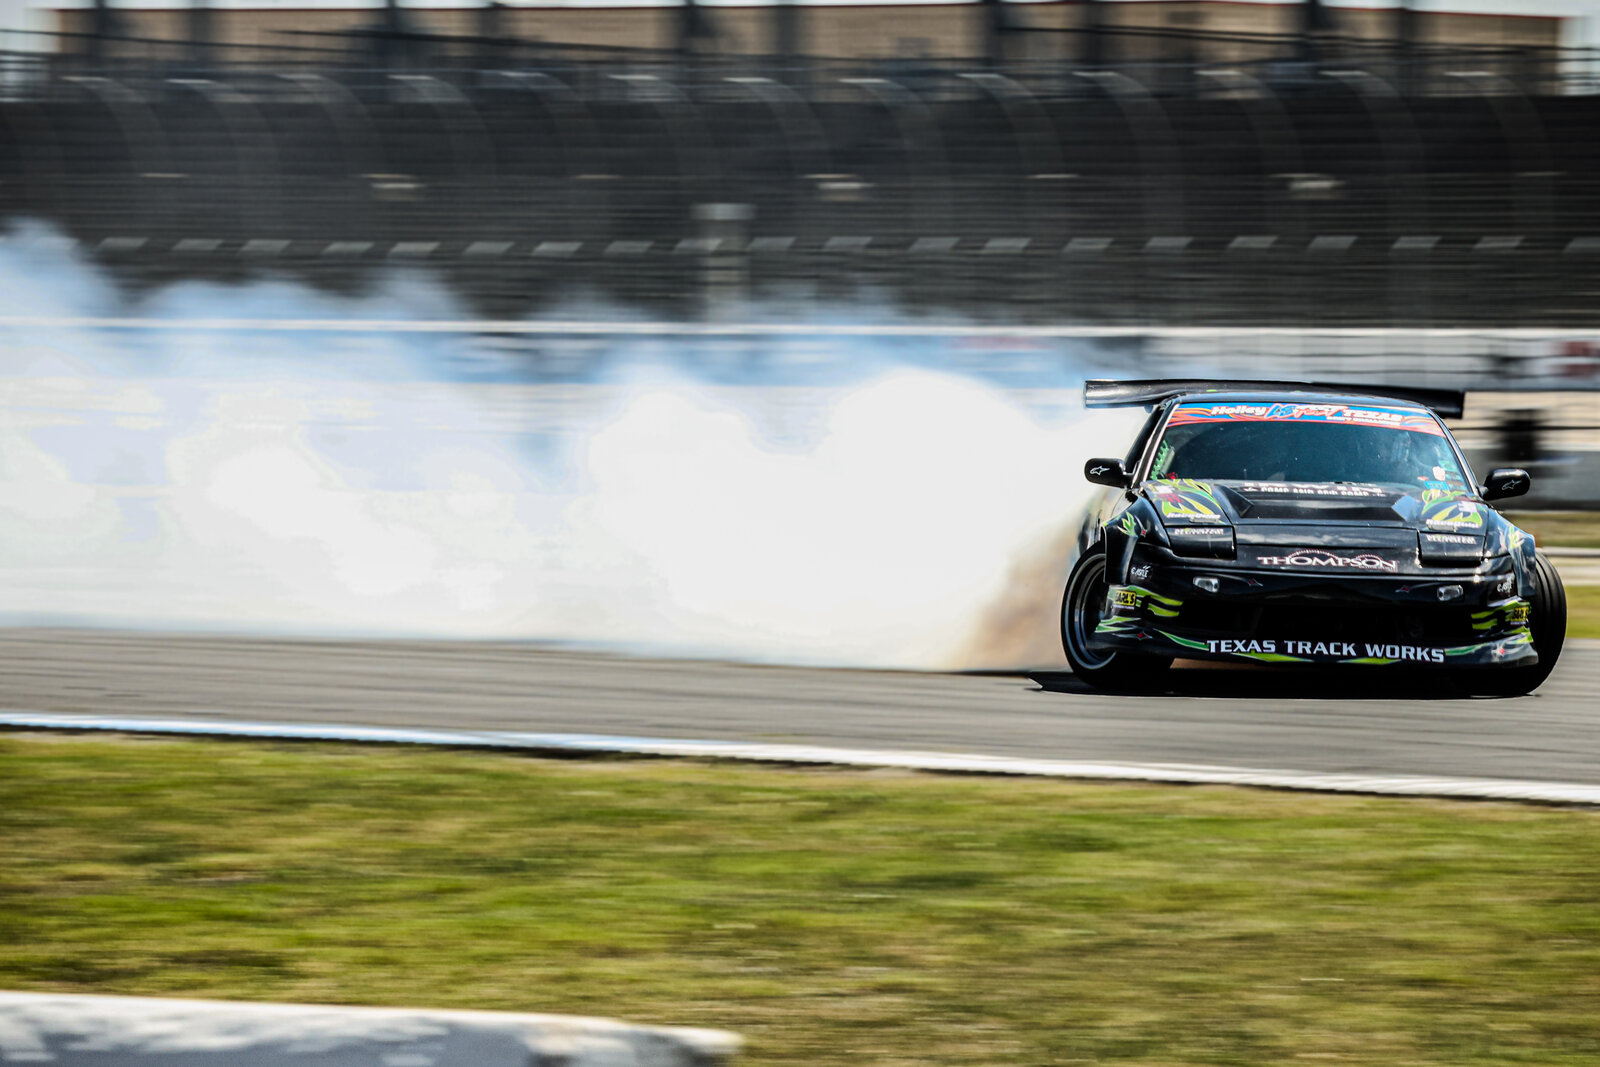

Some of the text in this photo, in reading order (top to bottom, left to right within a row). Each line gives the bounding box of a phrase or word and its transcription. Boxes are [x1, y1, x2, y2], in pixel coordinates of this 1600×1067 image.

[1211, 406, 1267, 416] Holley
[1343, 409, 1405, 422] TEXAS
[1256, 555, 1400, 573] THOMPSON
[1207, 639, 1445, 663] TEXAS TRACK WORKS
